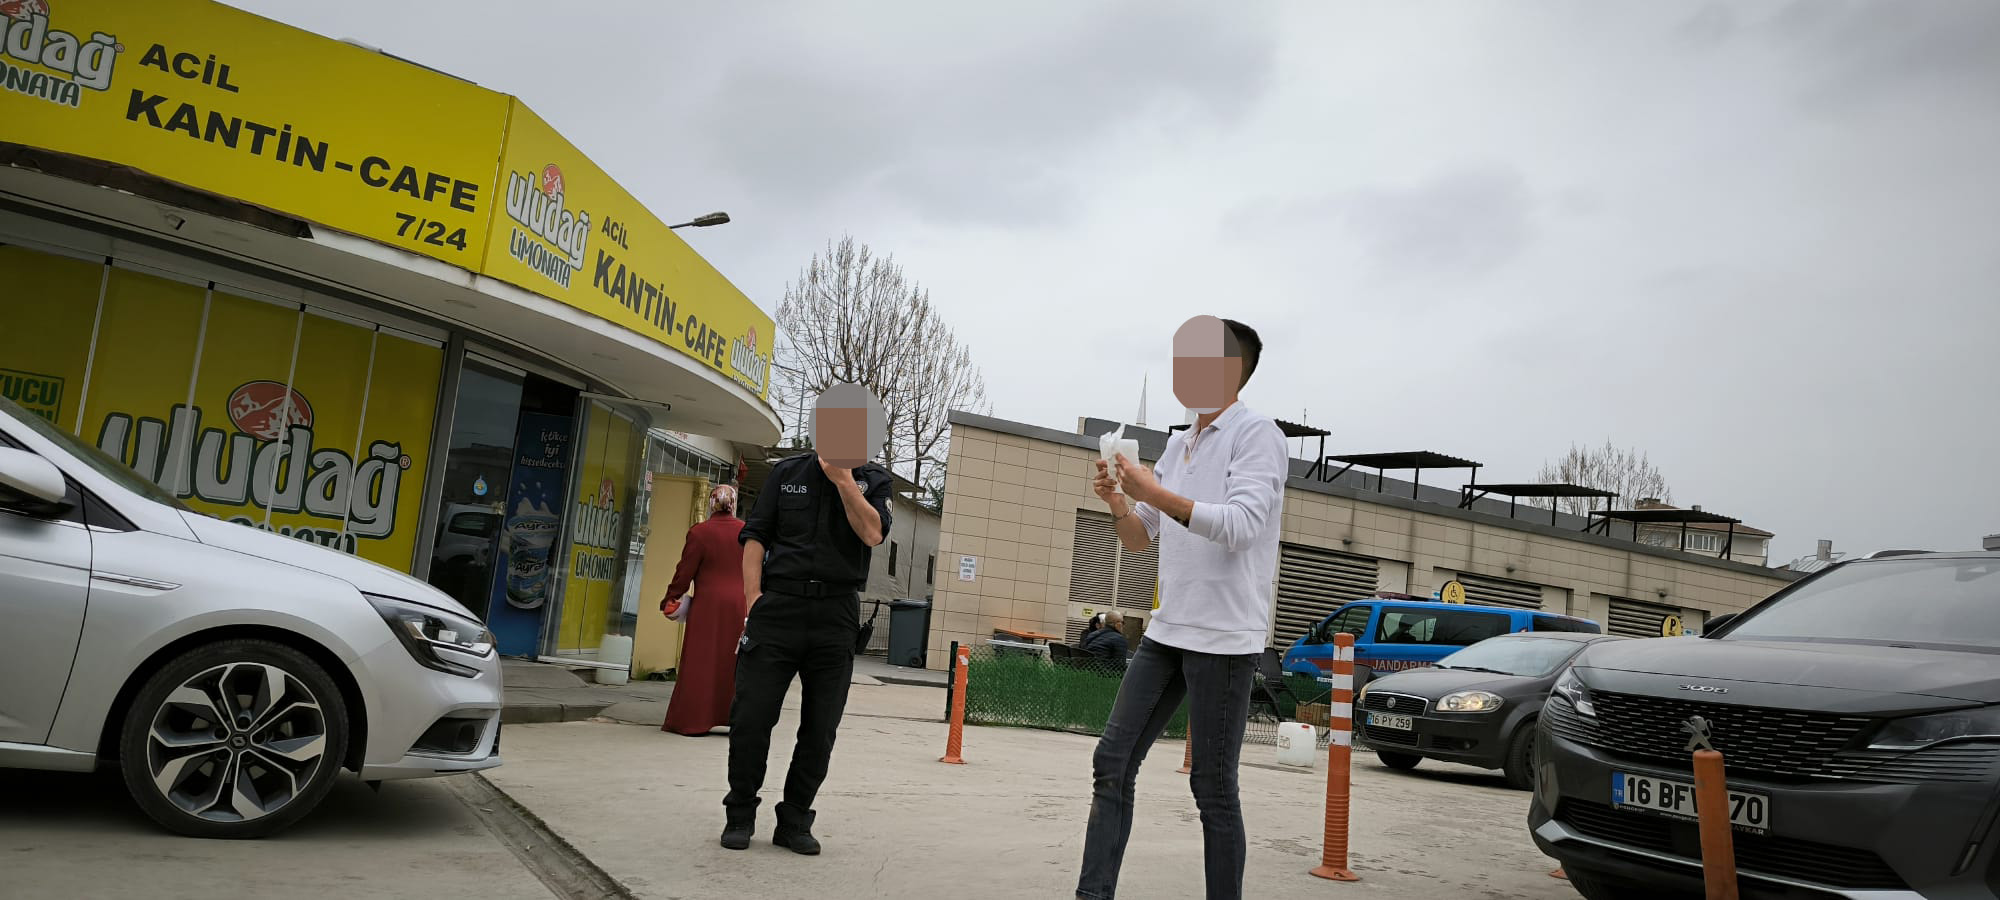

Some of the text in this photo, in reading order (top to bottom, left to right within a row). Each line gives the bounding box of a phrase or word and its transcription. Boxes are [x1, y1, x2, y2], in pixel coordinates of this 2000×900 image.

[139, 43, 240, 93] ACİL
[395, 212, 467, 251] 7/24
[506, 170, 590, 271] uludağ
[601, 215, 629, 250] ACİL
[509, 227, 571, 289] LİMONATA
[730, 334, 767, 394] uludağ
[0, 374, 58, 406] UCU
[515, 560, 545, 574] Ayra
[1670, 618, 1676, 631] P
[1678, 684, 1729, 693] 3008
[1382, 716, 1393, 726] PY
[1395, 718, 1410, 728] 259
[1627, 777, 1651, 804] 16
[1729, 794, 1763, 824] 70
